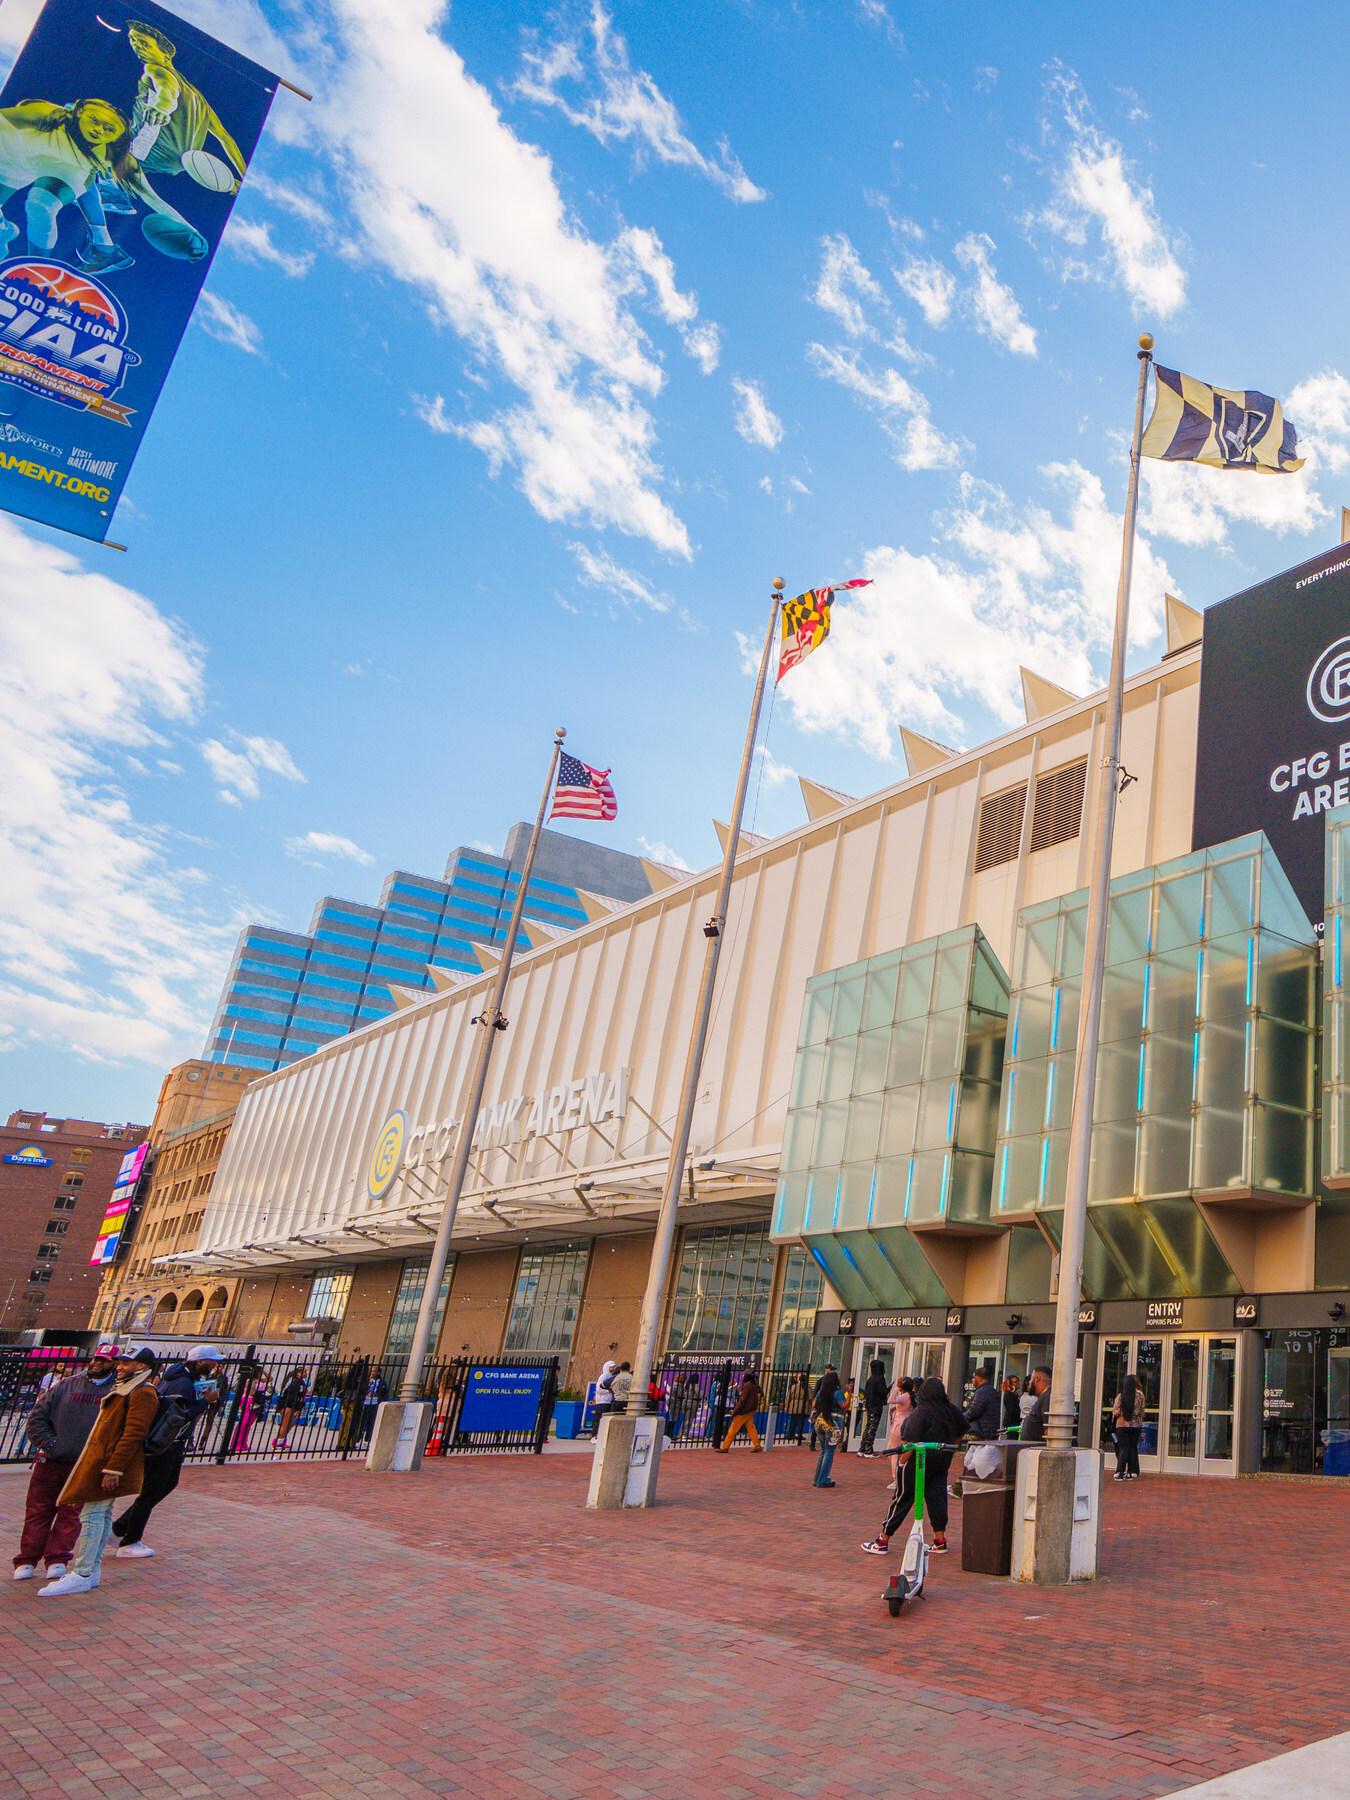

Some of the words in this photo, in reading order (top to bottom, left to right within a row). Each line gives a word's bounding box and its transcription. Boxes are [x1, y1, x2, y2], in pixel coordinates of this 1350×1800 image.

[73, 316, 118, 343] LION
[17, 367, 99, 404] TOURNAMENT
[35, 369, 58, 383] YEARS
[68, 383, 82, 391] THE
[20, 435, 63, 455] SPORTS
[71, 447, 93, 459] VISIT
[67, 457, 119, 480] BALTIMORE
[1270, 751, 1331, 793] CFG
[404, 1117, 457, 1170] CFG
[453, 1095, 530, 1152] ANK
[521, 1067, 628, 1142] ARENA
[1148, 1302, 1182, 1316] ENTRY
[867, 1318, 878, 1327] BOX
[878, 1317, 897, 1327] OFFICE
[902, 1316, 916, 1326] WILL
[916, 1316, 931, 1326] CALL
[1146, 1318, 1167, 1326] HOPKINS
[678, 1356, 687, 1364] VIP
